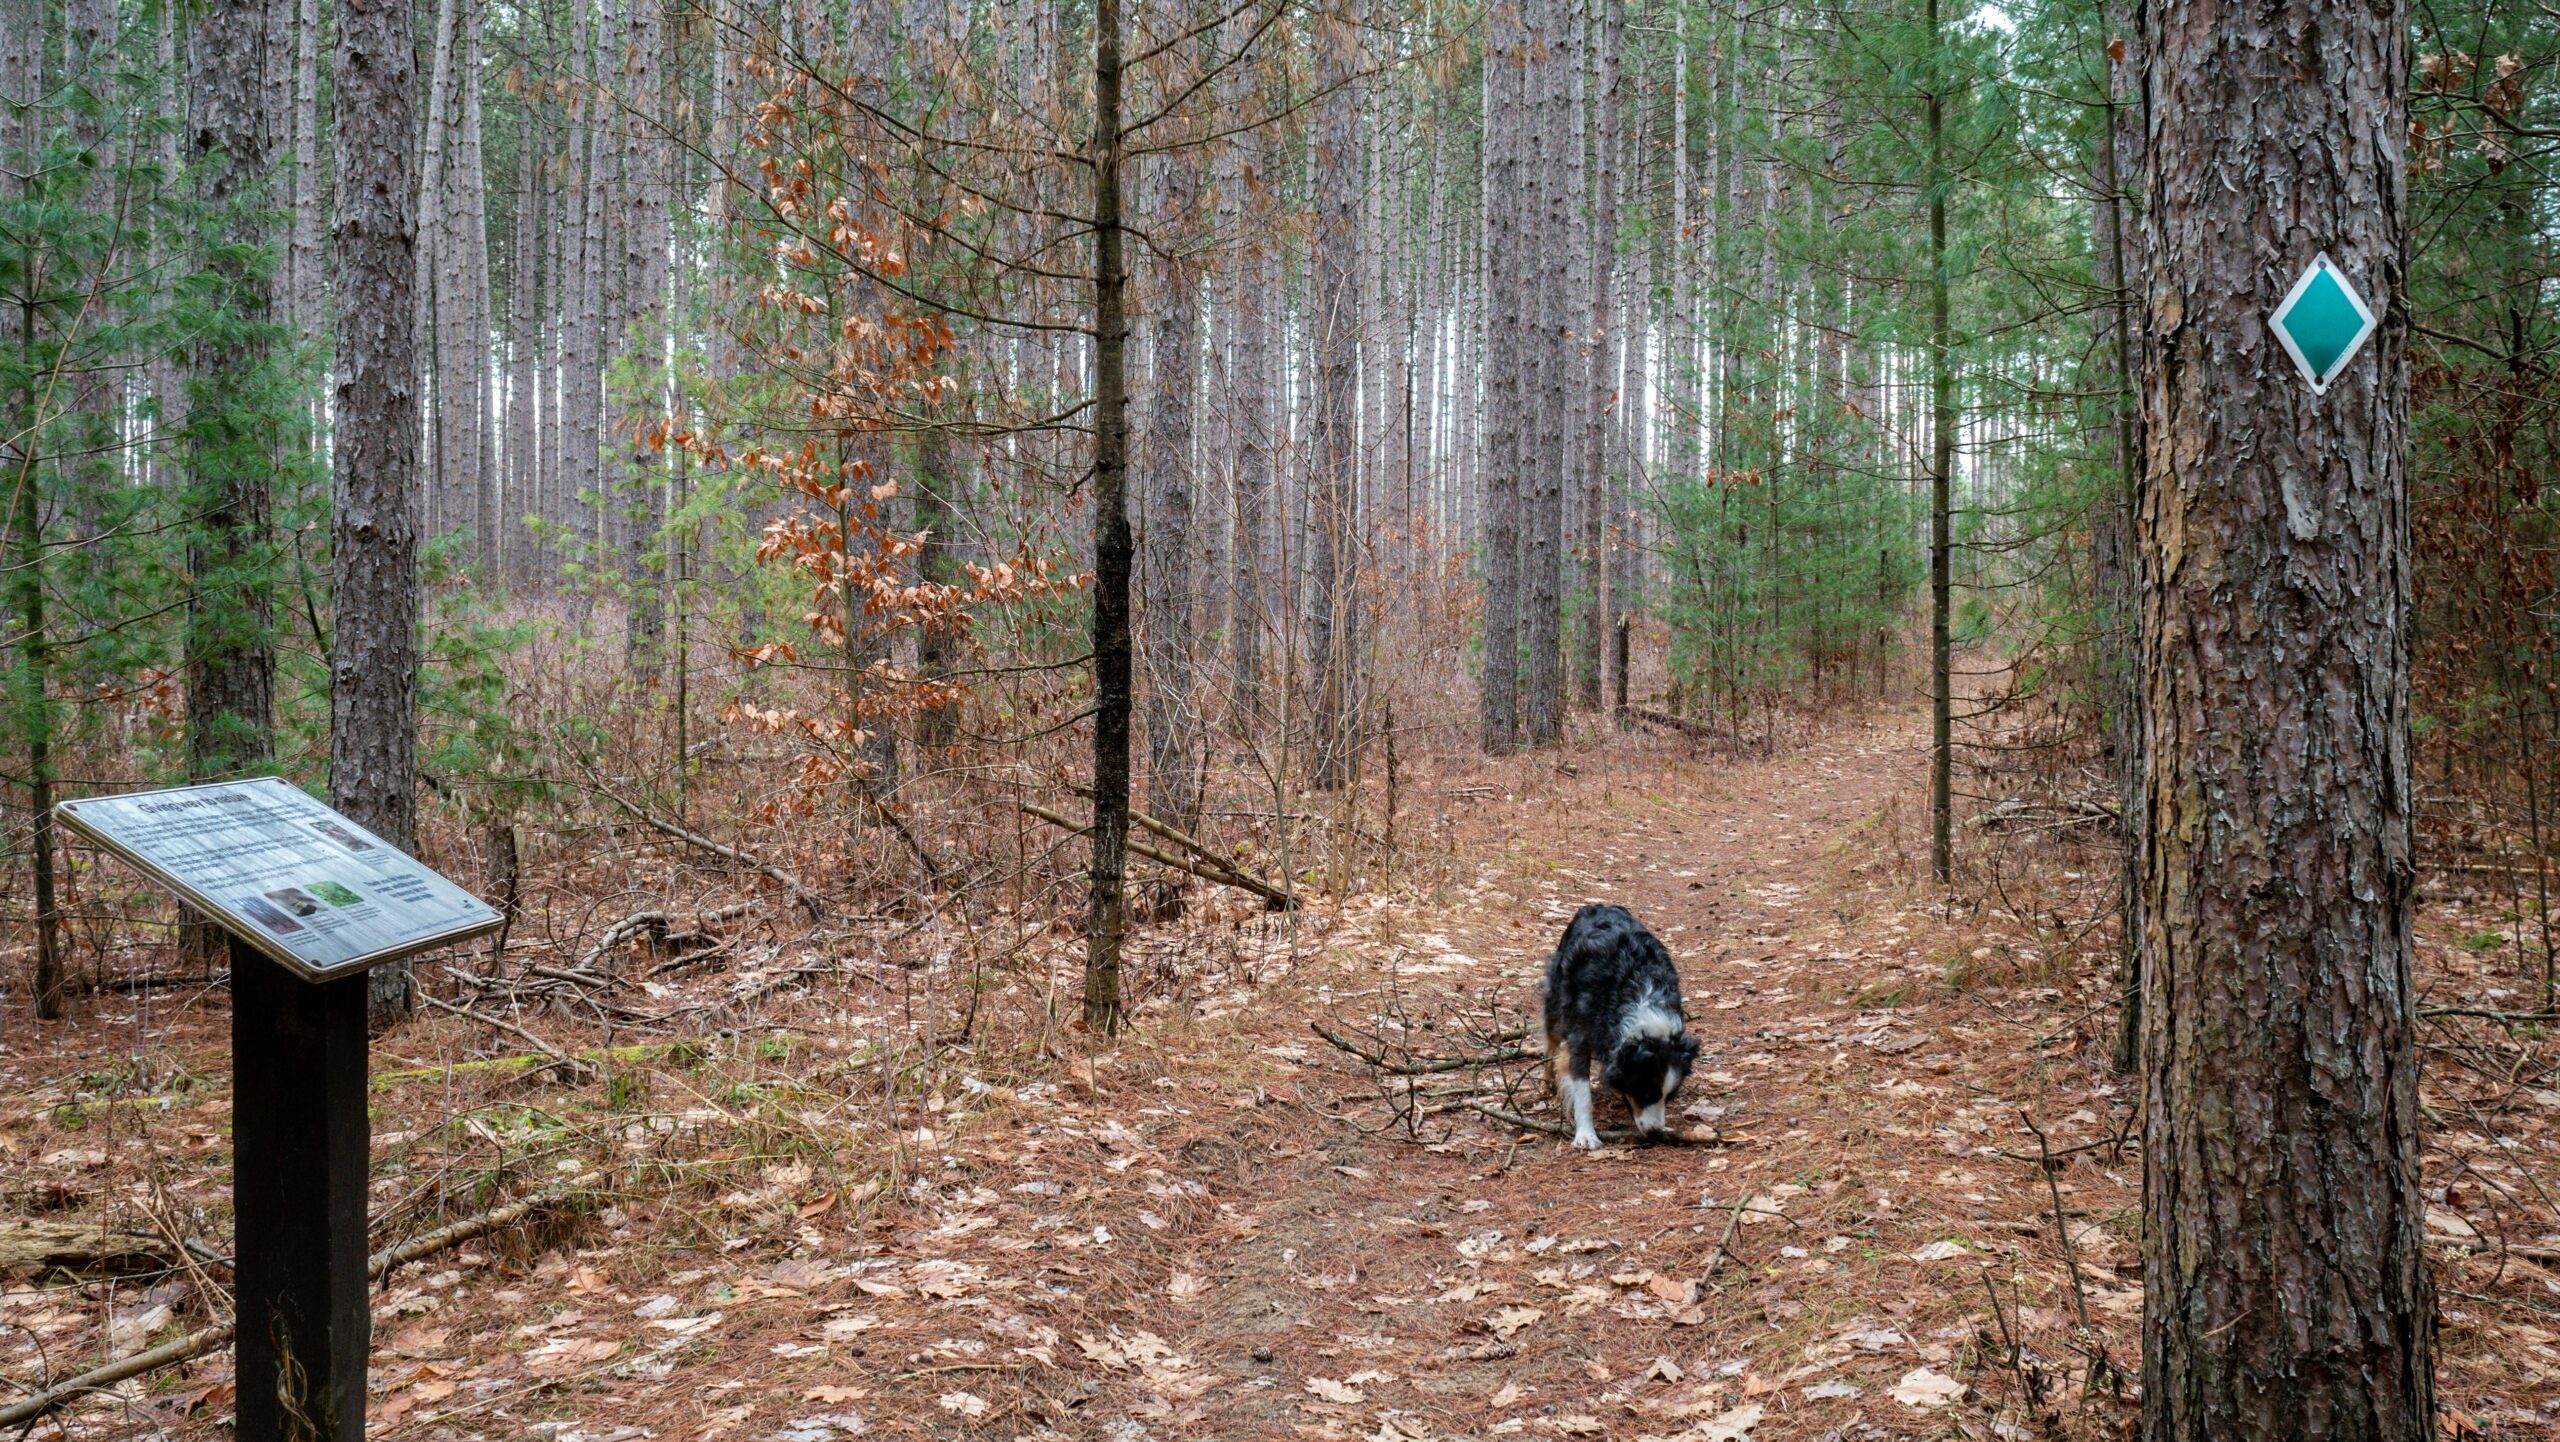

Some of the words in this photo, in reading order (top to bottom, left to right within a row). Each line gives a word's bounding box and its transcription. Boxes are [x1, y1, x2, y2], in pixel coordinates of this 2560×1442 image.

[137, 801, 183, 814] Giving
[179, 799, 206, 809] way
[200, 798, 217, 806] to
[214, 793, 252, 804] nature
